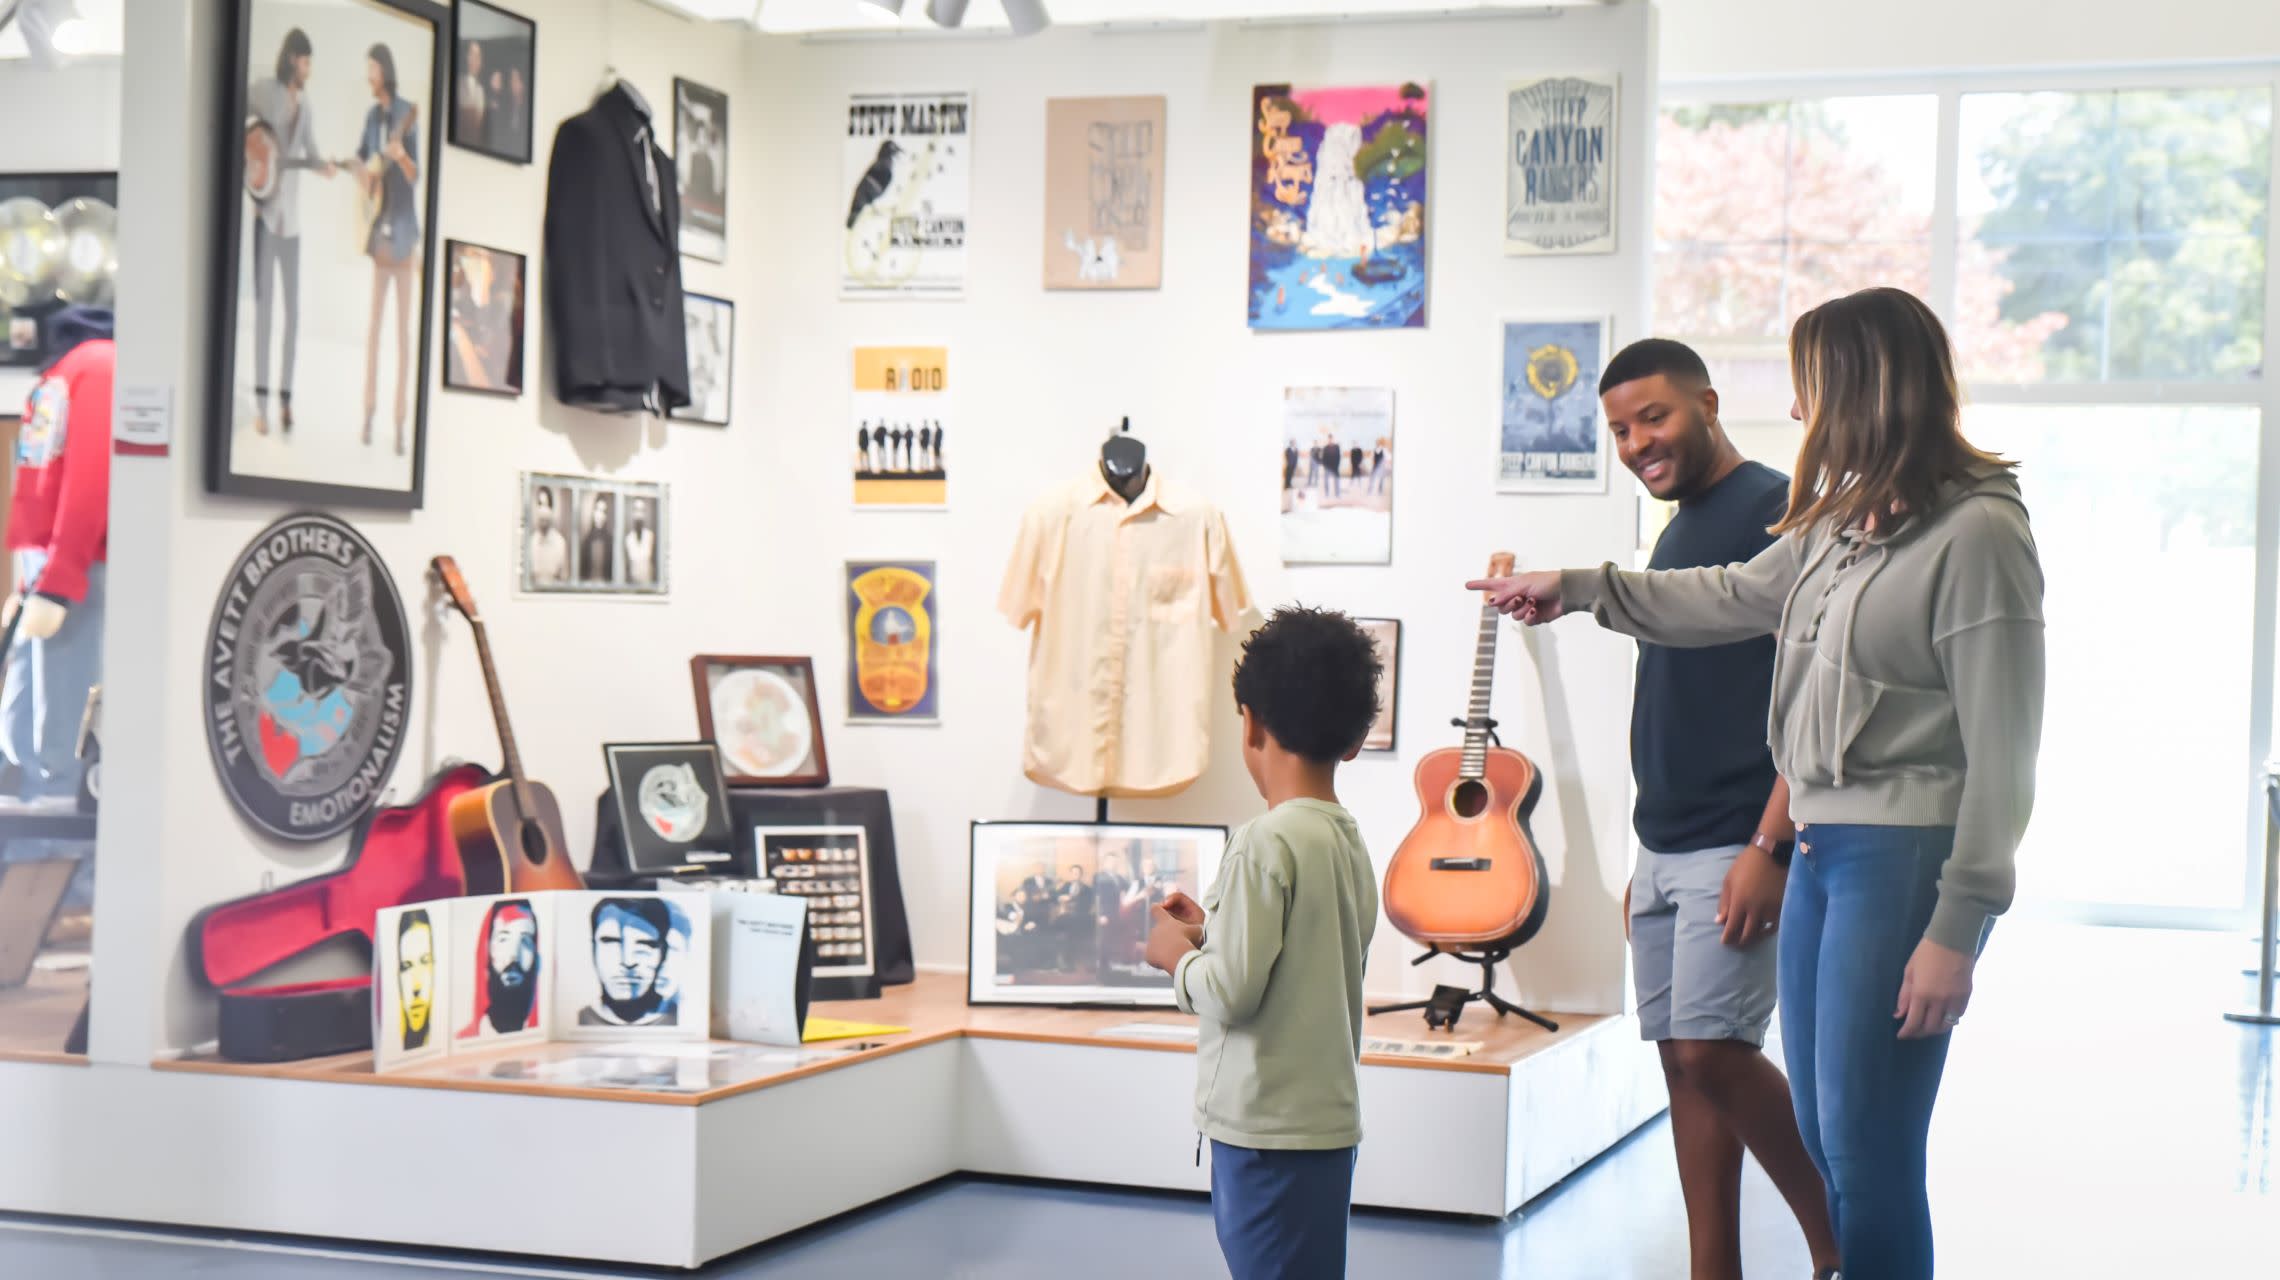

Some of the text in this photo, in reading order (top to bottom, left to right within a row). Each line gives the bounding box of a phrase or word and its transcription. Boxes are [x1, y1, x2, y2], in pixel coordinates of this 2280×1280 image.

[848, 103, 968, 136] STEVE MARTIN
[1516, 126, 1604, 166] CANYON
[213, 527, 354, 767] THE AVETT BROTHERS
[289, 683, 405, 826] EMOTIONALISM
